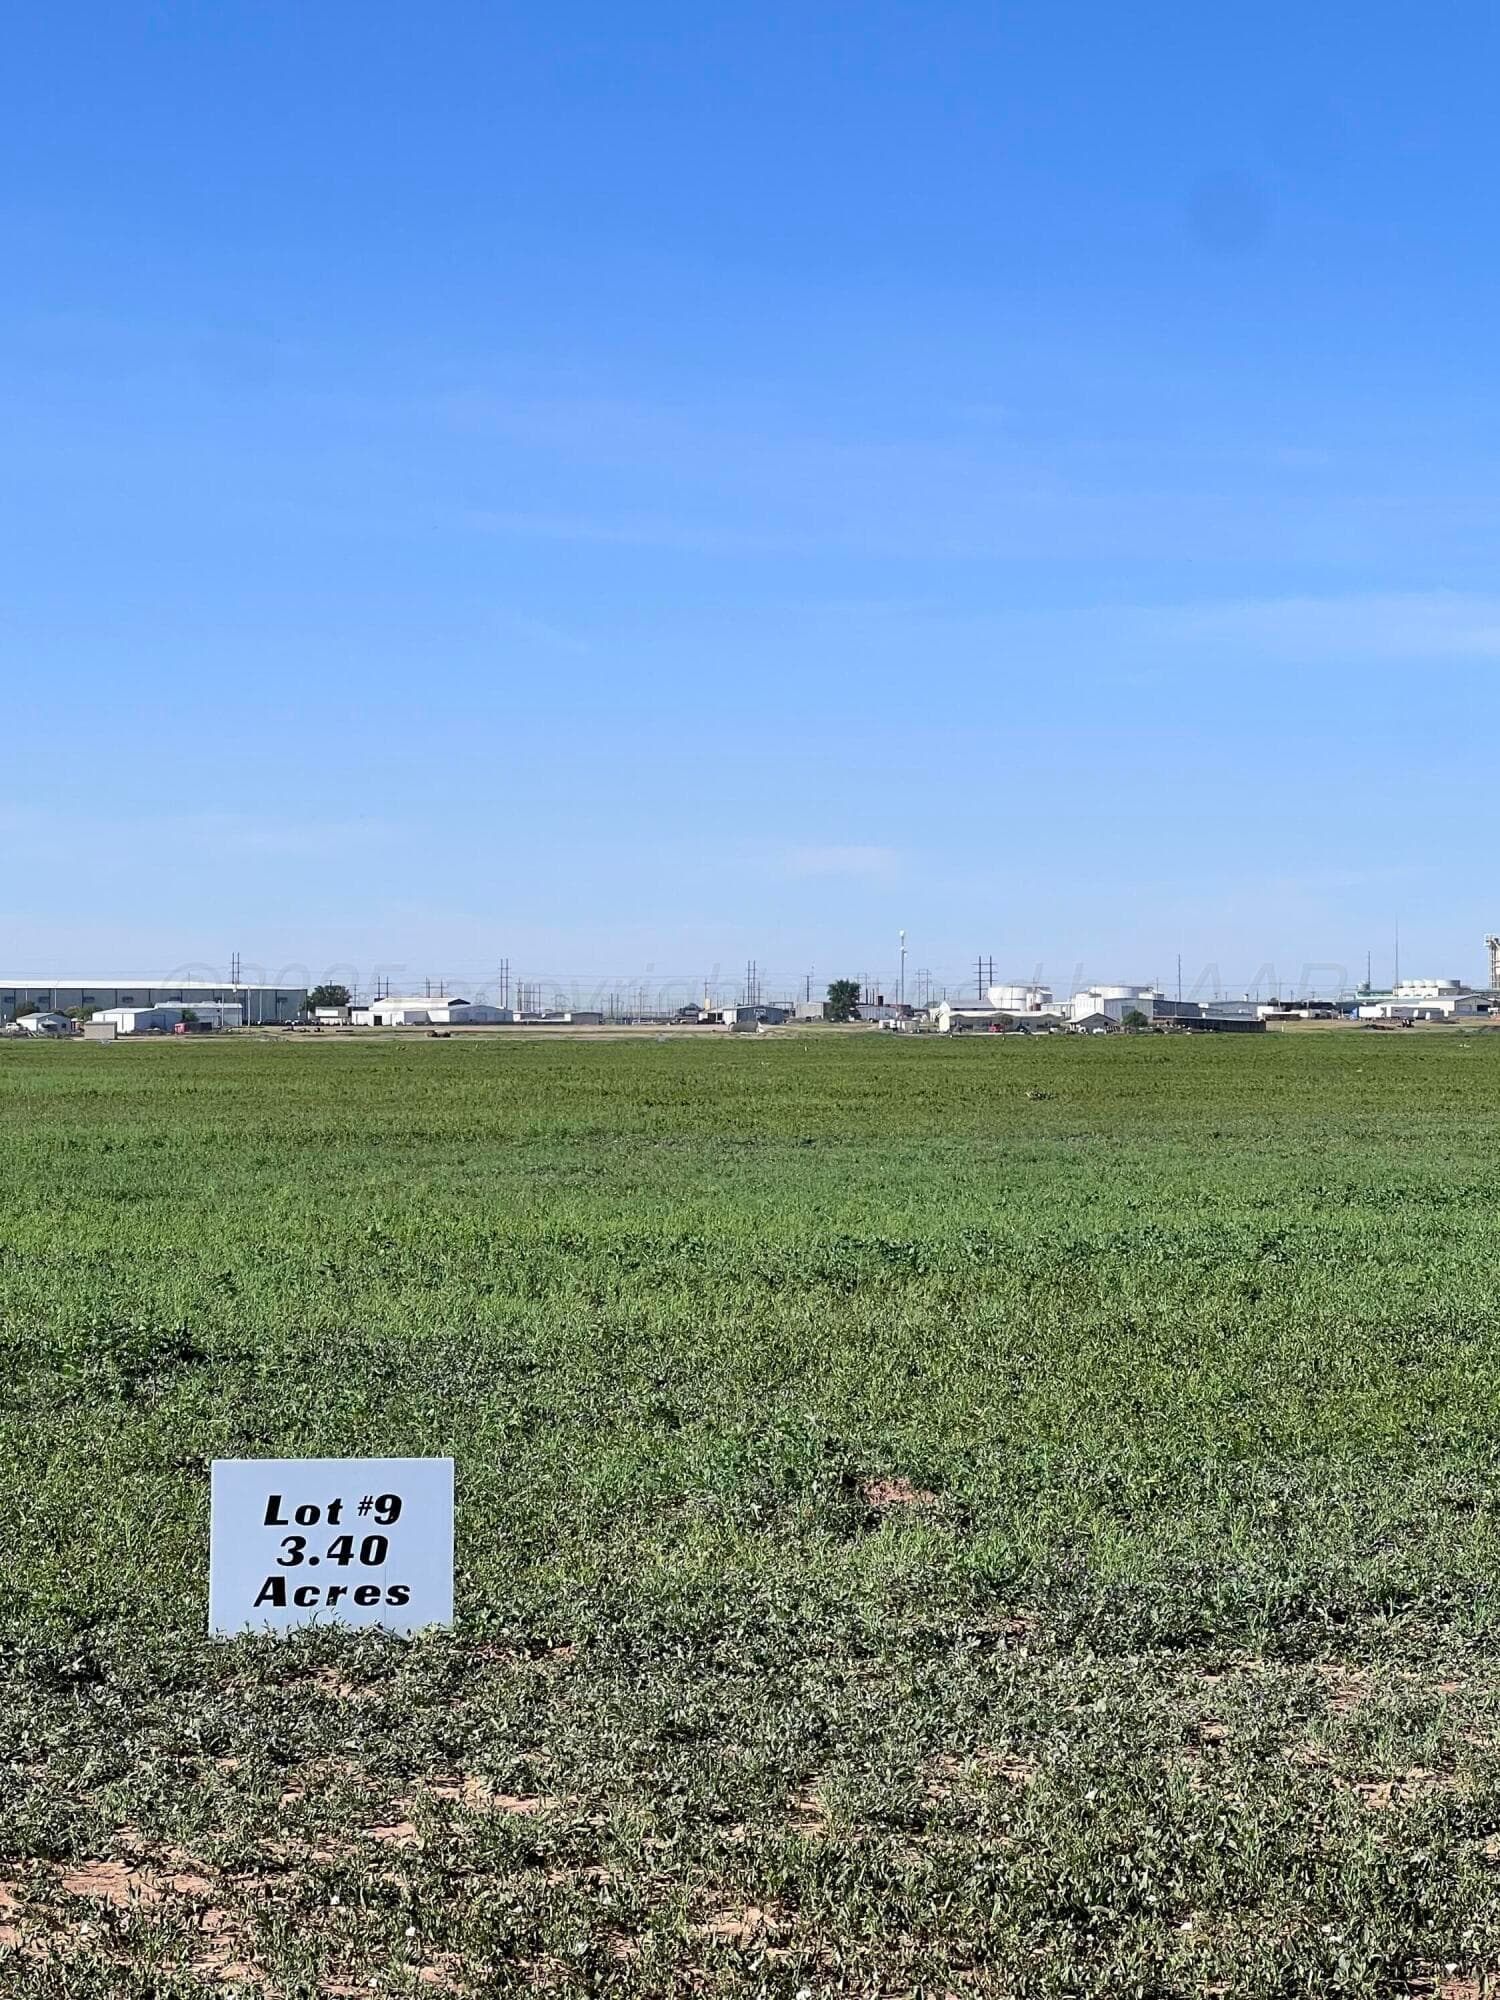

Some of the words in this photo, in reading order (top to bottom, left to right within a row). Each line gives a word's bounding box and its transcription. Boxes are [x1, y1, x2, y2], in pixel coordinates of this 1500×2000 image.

[264, 1495, 343, 1525] Lot
[358, 1494, 402, 1525] #9
[277, 1535, 388, 1566] 3.40
[254, 1576, 410, 1607] Acres
